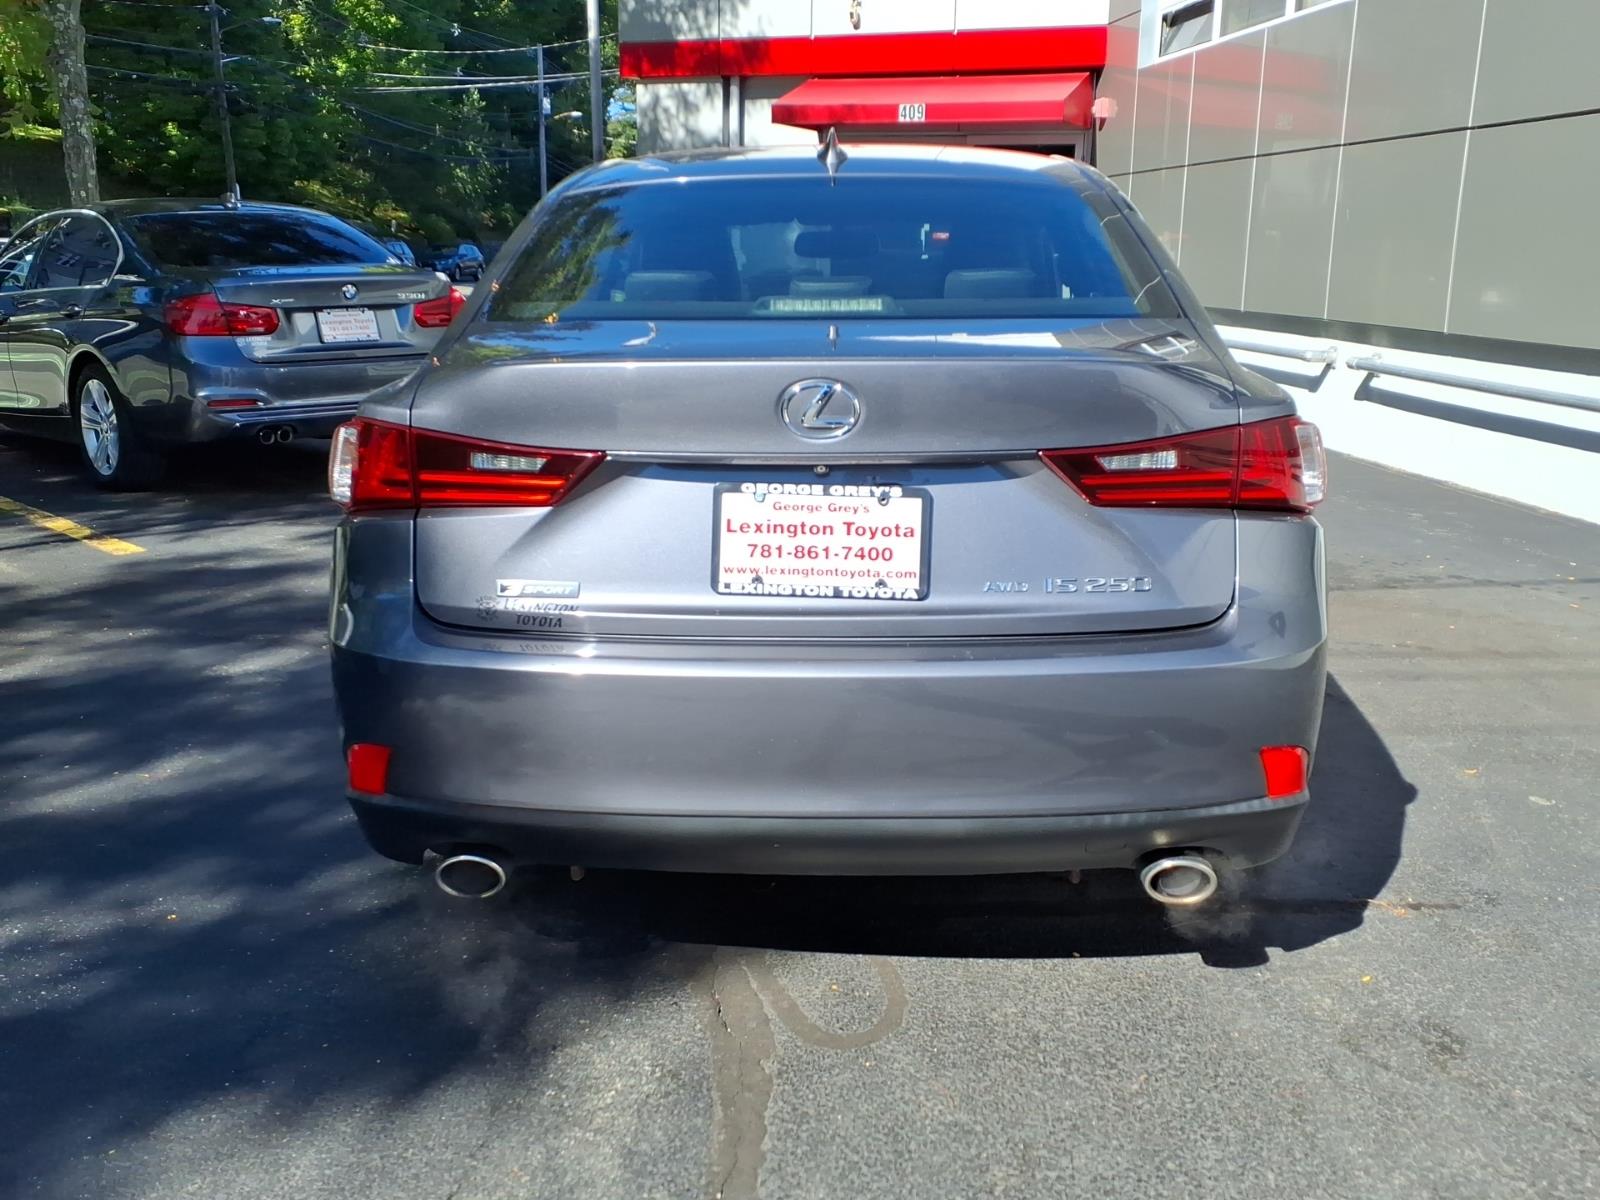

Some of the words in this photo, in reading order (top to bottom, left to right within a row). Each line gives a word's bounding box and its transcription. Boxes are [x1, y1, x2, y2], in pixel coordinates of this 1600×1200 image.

[900, 104, 924, 120] 409
[741, 483, 824, 496] GEORGE
[772, 501, 823, 513] George
[828, 502, 870, 514] Grey's
[726, 518, 835, 538] Lexington
[842, 521, 916, 540] Toyota
[747, 543, 894, 562] 781-861-7400
[723, 565, 918, 580] www.lexingtontoyota.com
[718, 583, 835, 598] LEXINGTON
[838, 586, 919, 600] TOYOTA
[983, 581, 1029, 593] AWD
[1044, 577, 1078, 593] IS
[1084, 576, 1152, 593] 250
[515, 613, 563, 628] TOYOTA
